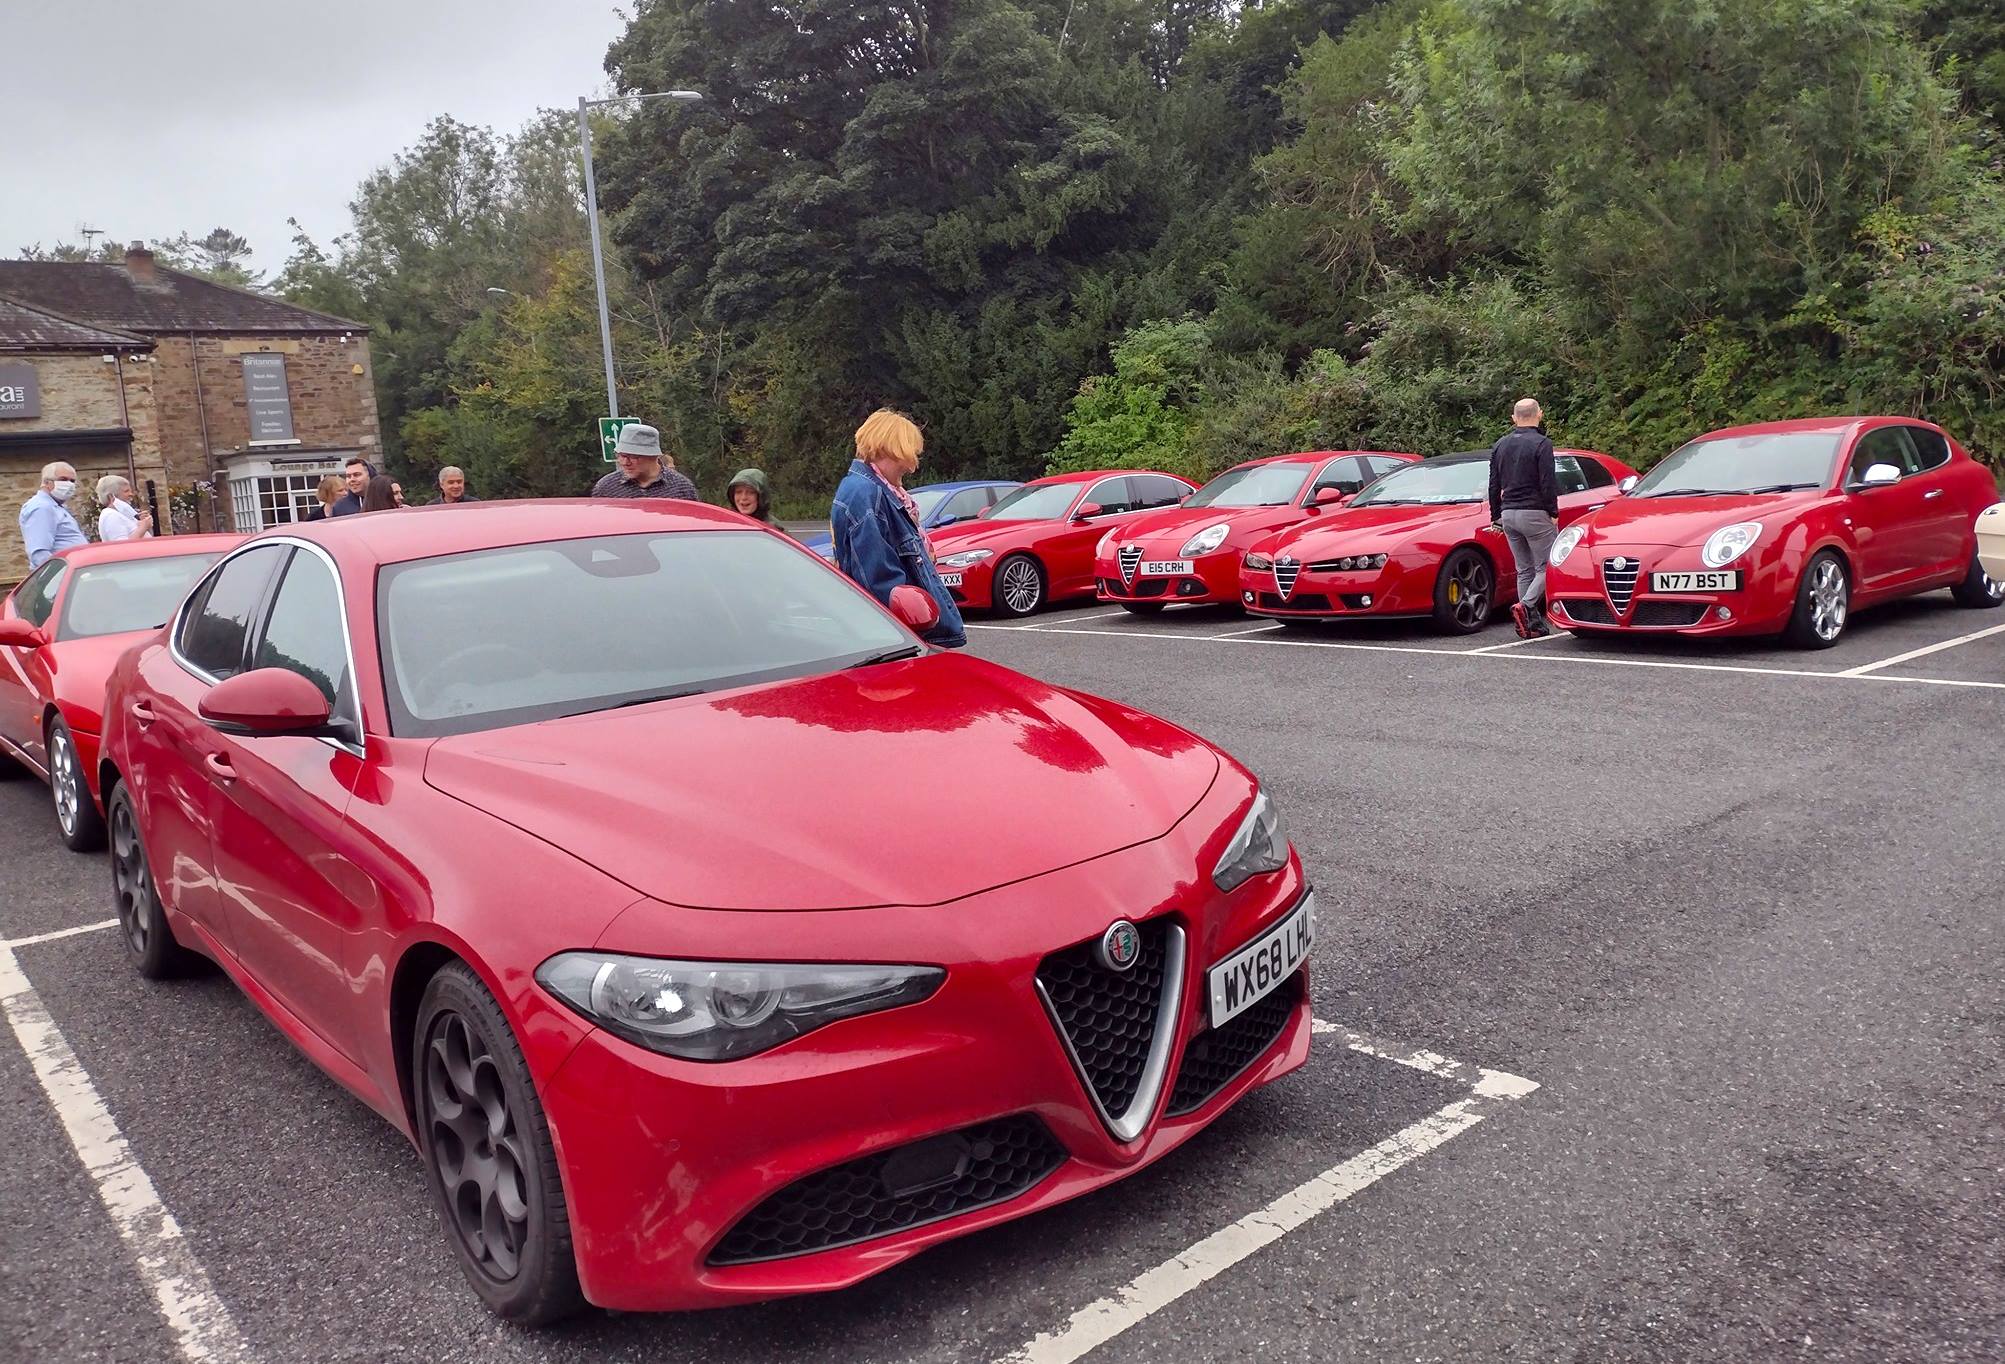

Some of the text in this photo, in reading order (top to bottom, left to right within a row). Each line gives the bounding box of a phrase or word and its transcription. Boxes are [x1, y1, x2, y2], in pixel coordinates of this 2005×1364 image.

[272, 461, 337, 473] Lounge Bar
[1164, 561, 1184, 573] CRH
[1660, 573, 1728, 589] N77 BST
[1224, 911, 1312, 1013] WX68 LHL
